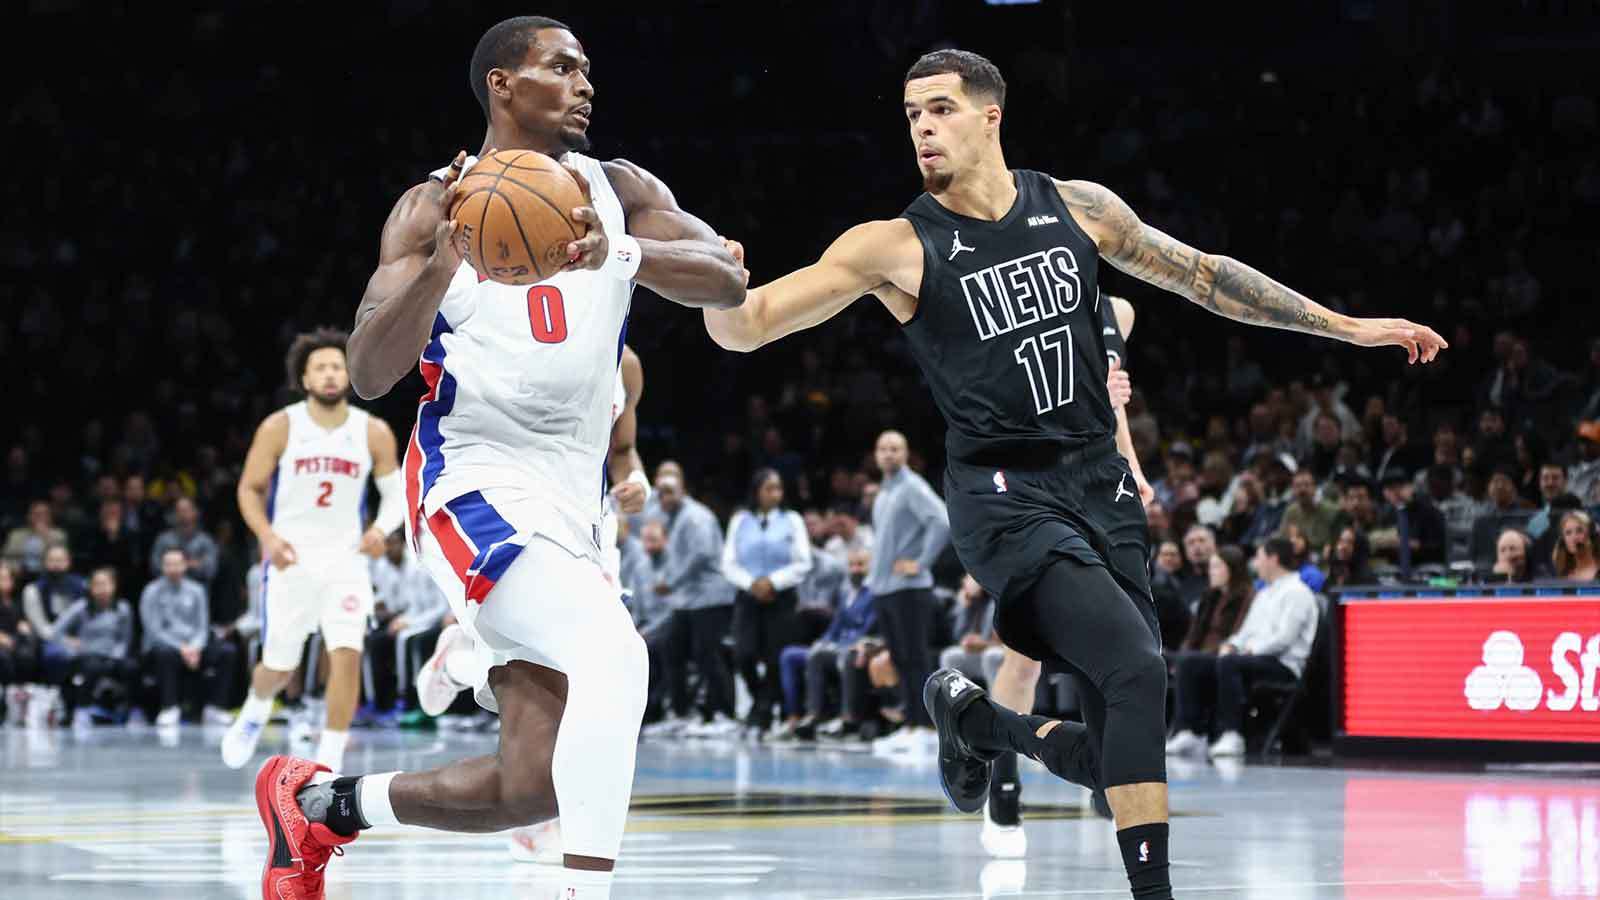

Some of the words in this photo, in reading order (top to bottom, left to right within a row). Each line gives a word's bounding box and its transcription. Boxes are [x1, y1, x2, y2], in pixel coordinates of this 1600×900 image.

[527, 284, 568, 344] 0
[959, 246, 1081, 341] NETS
[1013, 324, 1074, 415] 17
[294, 456, 359, 479] PISTONS
[316, 481, 334, 507] 2
